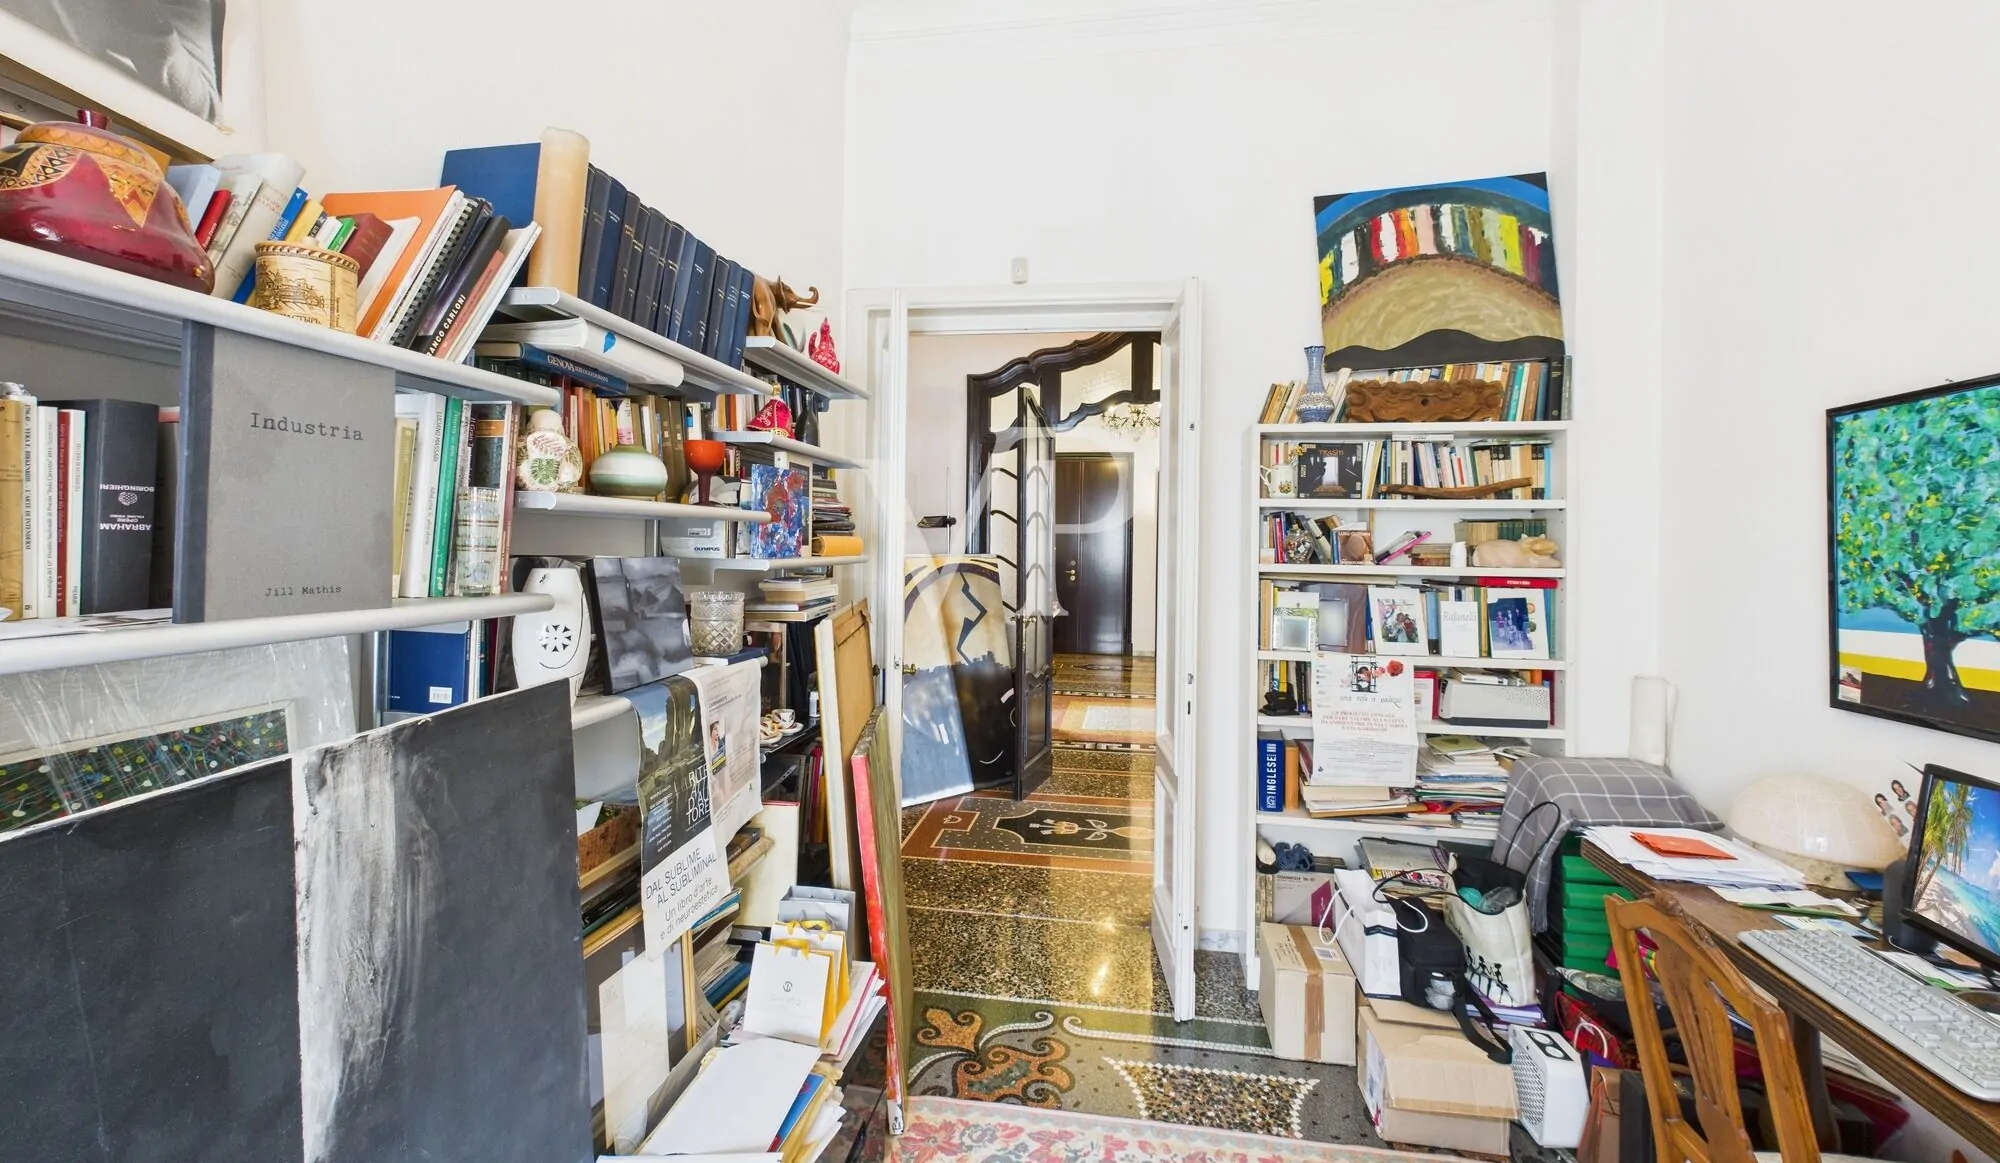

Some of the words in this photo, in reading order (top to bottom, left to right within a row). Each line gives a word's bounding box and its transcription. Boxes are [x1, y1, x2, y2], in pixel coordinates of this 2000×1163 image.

[427, 330, 445, 357] RANCO
[444, 294, 466, 330] CARLONI
[546, 355, 575, 372] GENOVA
[250, 412, 364, 441] Industria
[434, 412, 442, 437] LUCIANO
[432, 437, 440, 462] MASSARI
[100, 484, 155, 492] BORINGHIERI
[99, 523, 152, 531] ABRAHAM
[265, 586, 293, 597] Jill
[302, 586, 342, 595] Mathis
[1266, 756, 1277, 794] INGLESE
[686, 800, 710, 826] TORE
[646, 879, 663, 899] DAL
[664, 848, 702, 884] SUBLIME
[657, 891, 668, 908] AL
[660, 931, 665, 939] e
[667, 922, 674, 934] di
[675, 885, 719, 925] neuroestetica
[665, 906, 676, 922] Un
[677, 893, 692, 911] libro
[694, 877, 712, 897] d'arte
